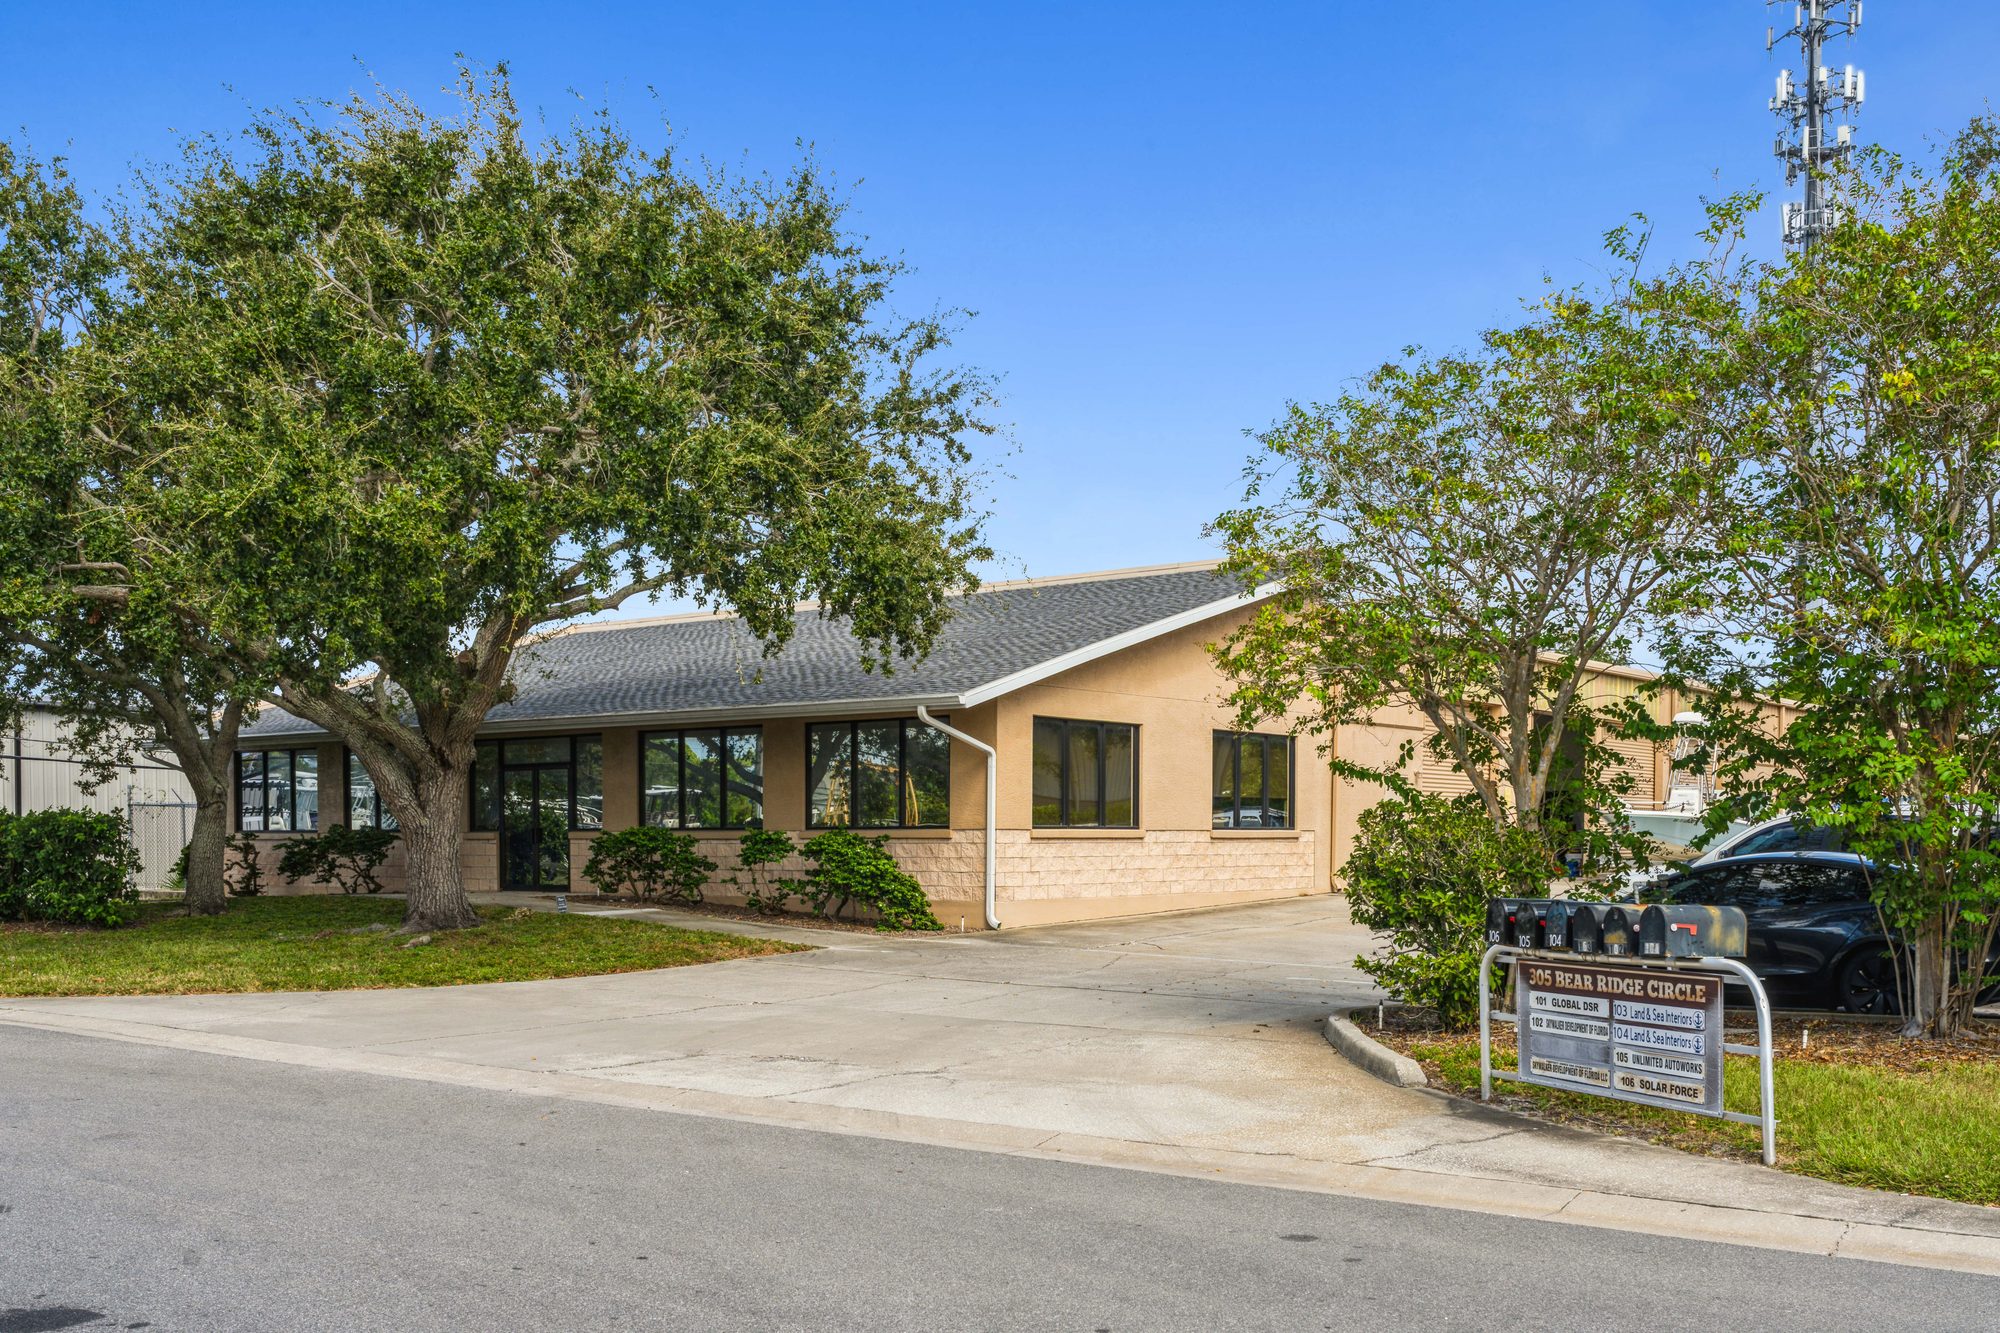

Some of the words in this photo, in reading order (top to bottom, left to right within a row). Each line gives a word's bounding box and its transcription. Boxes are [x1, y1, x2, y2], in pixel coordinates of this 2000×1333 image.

[1489, 930, 1500, 942] 106
[1519, 935, 1531, 947] 105
[1549, 934, 1561, 946] 104
[1529, 968, 1552, 987] 305
[1555, 971, 1594, 991] BEAR
[1596, 974, 1644, 996] RIDGE
[1647, 980, 1706, 1003] CIRCLE
[1535, 996, 1547, 1006] 101
[1551, 998, 1581, 1010] GLOBAL
[1583, 1001, 1599, 1012] DSR
[1613, 1004, 1628, 1017] 103
[1630, 1006, 1645, 1019] Land
[1646, 1008, 1651, 1021] &
[1652, 1008, 1664, 1022] Sea
[1665, 1010, 1692, 1026] Interiors
[1531, 1017, 1543, 1027] 102
[1565, 1021, 1588, 1034] DEVELOPMENT
[1589, 1024, 1594, 1034] OF
[1594, 1025, 1608, 1037] FLORIDA
[1613, 1027, 1629, 1040] 104
[1630, 1028, 1645, 1042] Land
[1645, 1030, 1651, 1043] &
[1652, 1031, 1664, 1045] Sea
[1665, 1032, 1692, 1049] Interiors
[1532, 1061, 1552, 1072] SKYWALKER
[1552, 1064, 1578, 1077] DEVELOPMENT
[1578, 1069, 1584, 1078] OF
[1584, 1070, 1600, 1081] FLORIDA
[1600, 1073, 1608, 1082] LLC
[1616, 1051, 1628, 1063] 105
[1632, 1054, 1663, 1069] UNLIMITED
[1664, 1059, 1703, 1074] AUTOWORKS
[1621, 1076, 1635, 1087] 106
[1639, 1079, 1667, 1093] SOLAR
[1669, 1084, 1699, 1098] FORCE
